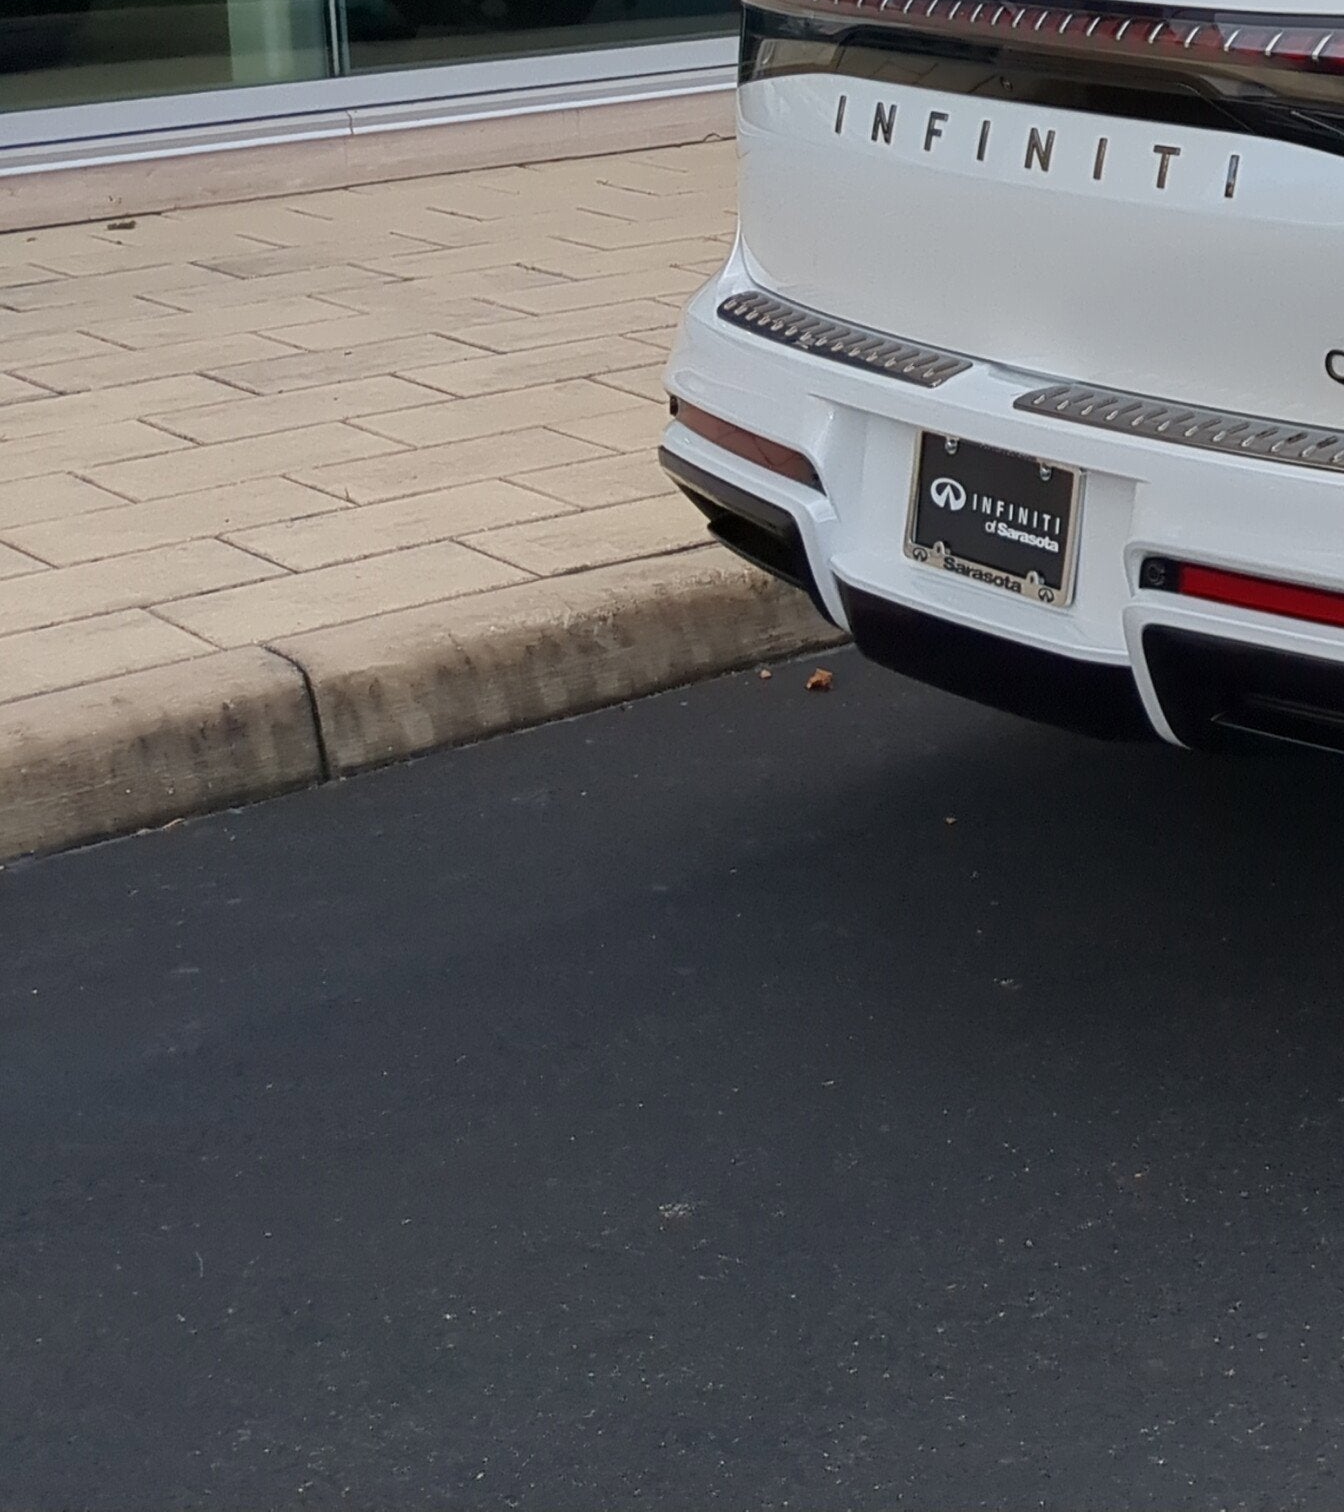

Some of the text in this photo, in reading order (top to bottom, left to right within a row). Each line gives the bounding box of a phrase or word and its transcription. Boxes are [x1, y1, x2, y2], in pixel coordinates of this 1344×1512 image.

[834, 94, 1241, 199] INFINITI
[972, 494, 1060, 535] INFINITI
[985, 520, 1059, 553] of Sarasota
[943, 556, 1022, 593] Sarasota
